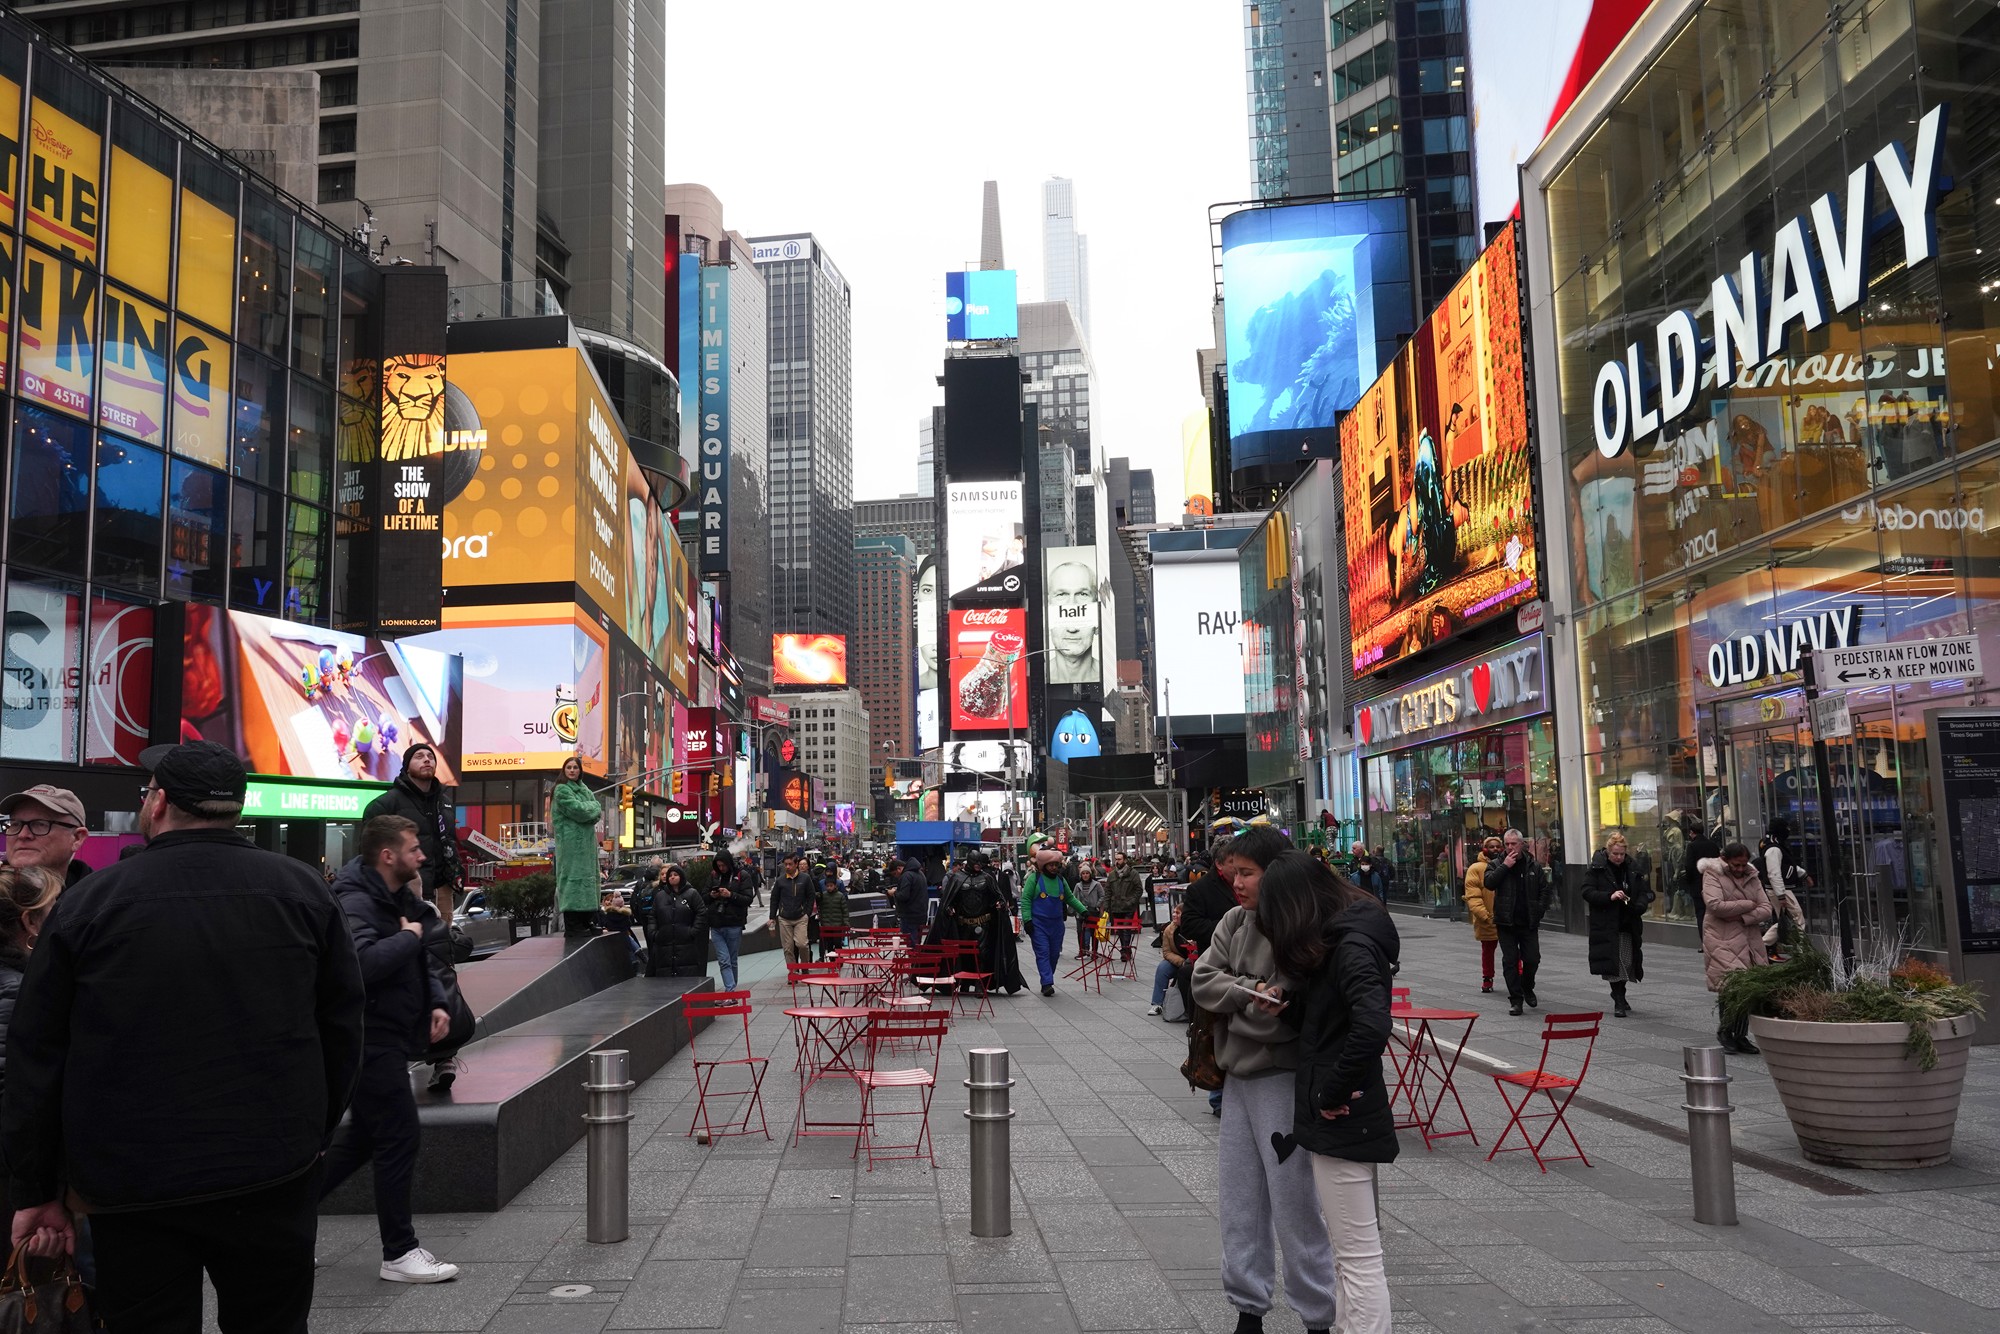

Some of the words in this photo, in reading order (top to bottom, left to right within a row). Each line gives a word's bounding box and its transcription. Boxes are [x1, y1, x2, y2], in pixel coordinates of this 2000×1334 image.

[1594, 309, 1698, 459] OLD
[1711, 103, 1949, 390] NAVY
[965, 303, 990, 316] Plan
[56, 244, 211, 402] KING
[703, 281, 723, 395] TIMES
[25, 376, 46, 395] ON
[54, 388, 85, 409] 45TH
[101, 405, 138, 429] STREET
[588, 397, 619, 477] JANELLE
[401, 466, 425, 482] THE
[394, 482, 430, 498] SHOW
[703, 413, 723, 555] SQUARE
[951, 490, 1018, 502] SAMSUNG
[398, 499, 414, 514] OF
[416, 499, 425, 514] A
[384, 515, 439, 531] LIFETIME
[589, 550, 615, 598] pandora
[962, 608, 1010, 626] Coca-Cola
[1059, 604, 1088, 618] half
[380, 619, 437, 627] LIONKING.COM
[995, 632, 1021, 641] Coke
[1708, 634, 1767, 688] OLD
[1765, 605, 1858, 675] NAVY
[1834, 648, 1904, 667] PEDESTRIAN
[1906, 644, 1938, 660] FLOW
[1942, 641, 1973, 656] ZONE
[1898, 664, 1926, 678] KEEP
[1930, 658, 1976, 675] MOVING
[1400, 678, 1458, 735] GIFTS
[1489, 647, 1539, 710] NY
[466, 758, 493, 766] SWISS
[494, 757, 519, 766] MADE
[1786, 775, 1817, 789] OLD
[281, 792, 308, 809] LINE
[311, 793, 359, 811] FRIENDS
[473, 834, 486, 846] NORTH
[486, 842, 498, 853] SHORE
